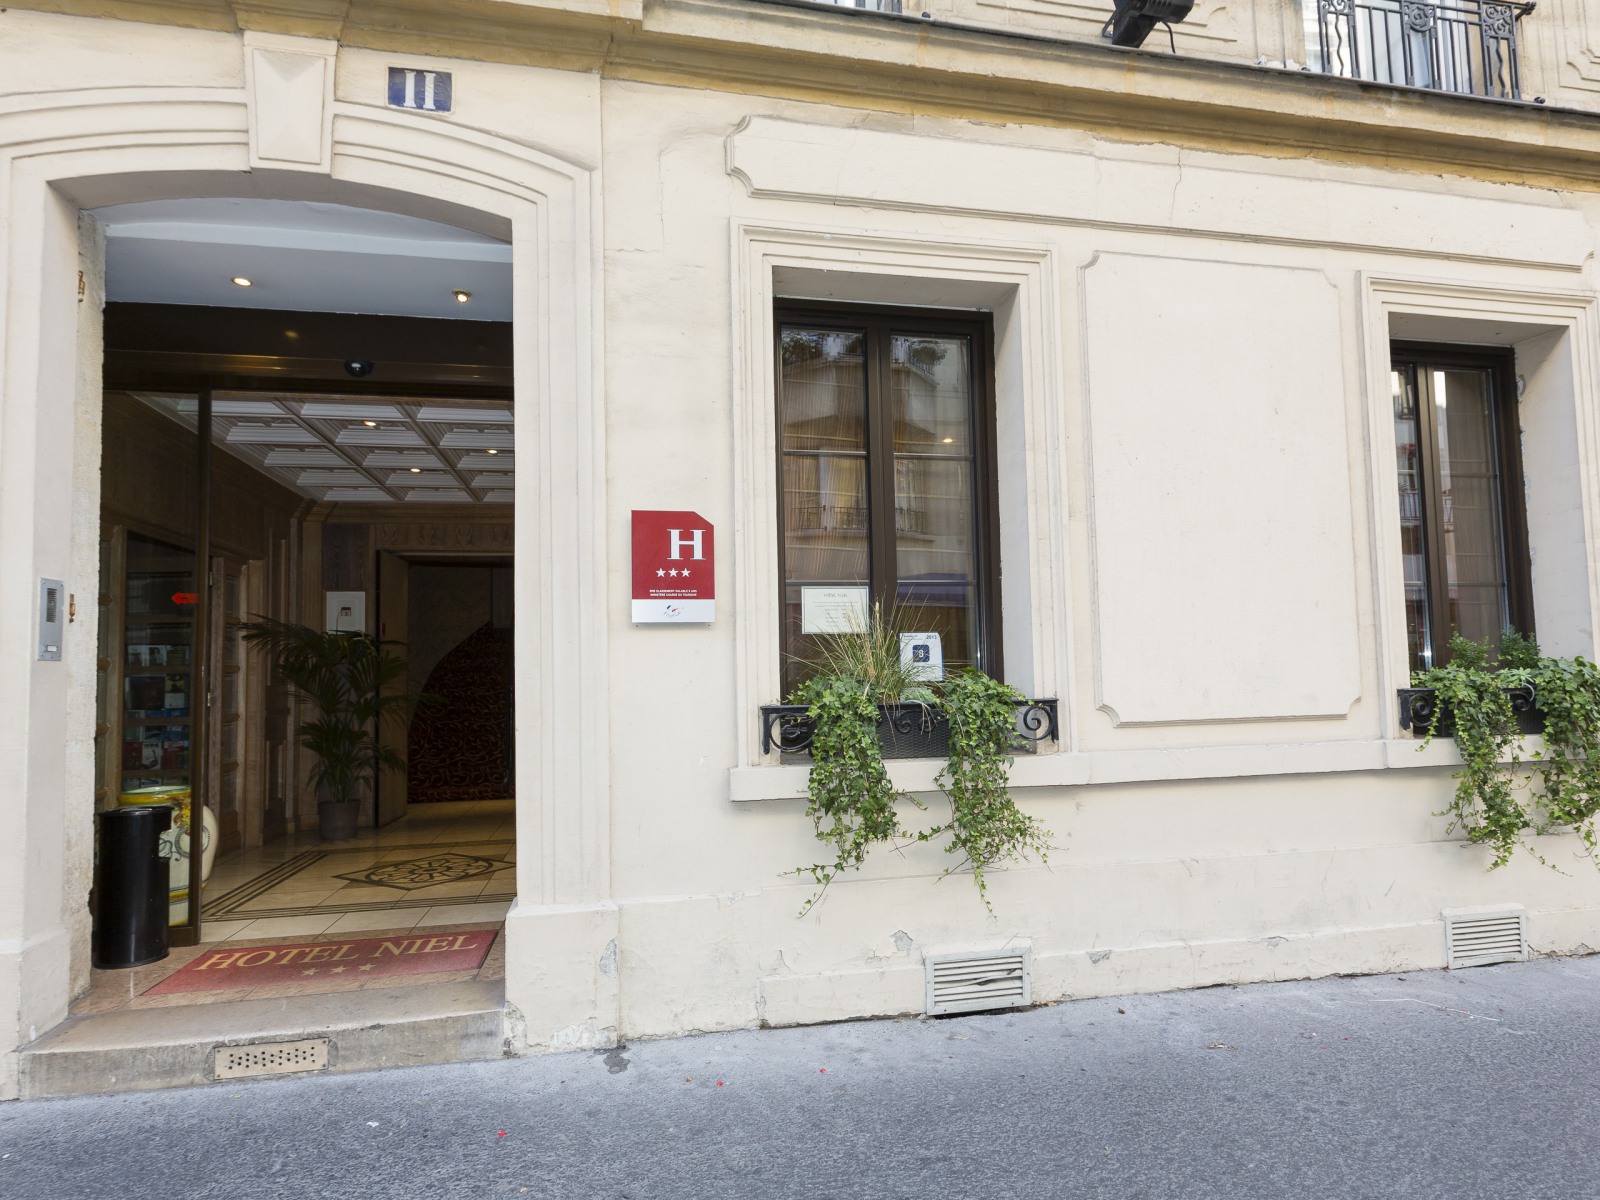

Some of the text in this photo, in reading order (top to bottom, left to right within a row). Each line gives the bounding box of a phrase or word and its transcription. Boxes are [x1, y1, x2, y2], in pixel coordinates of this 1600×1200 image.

[403, 70, 436, 110] 11
[667, 529, 706, 560] H
[192, 935, 478, 971] HOTEL NIEL
